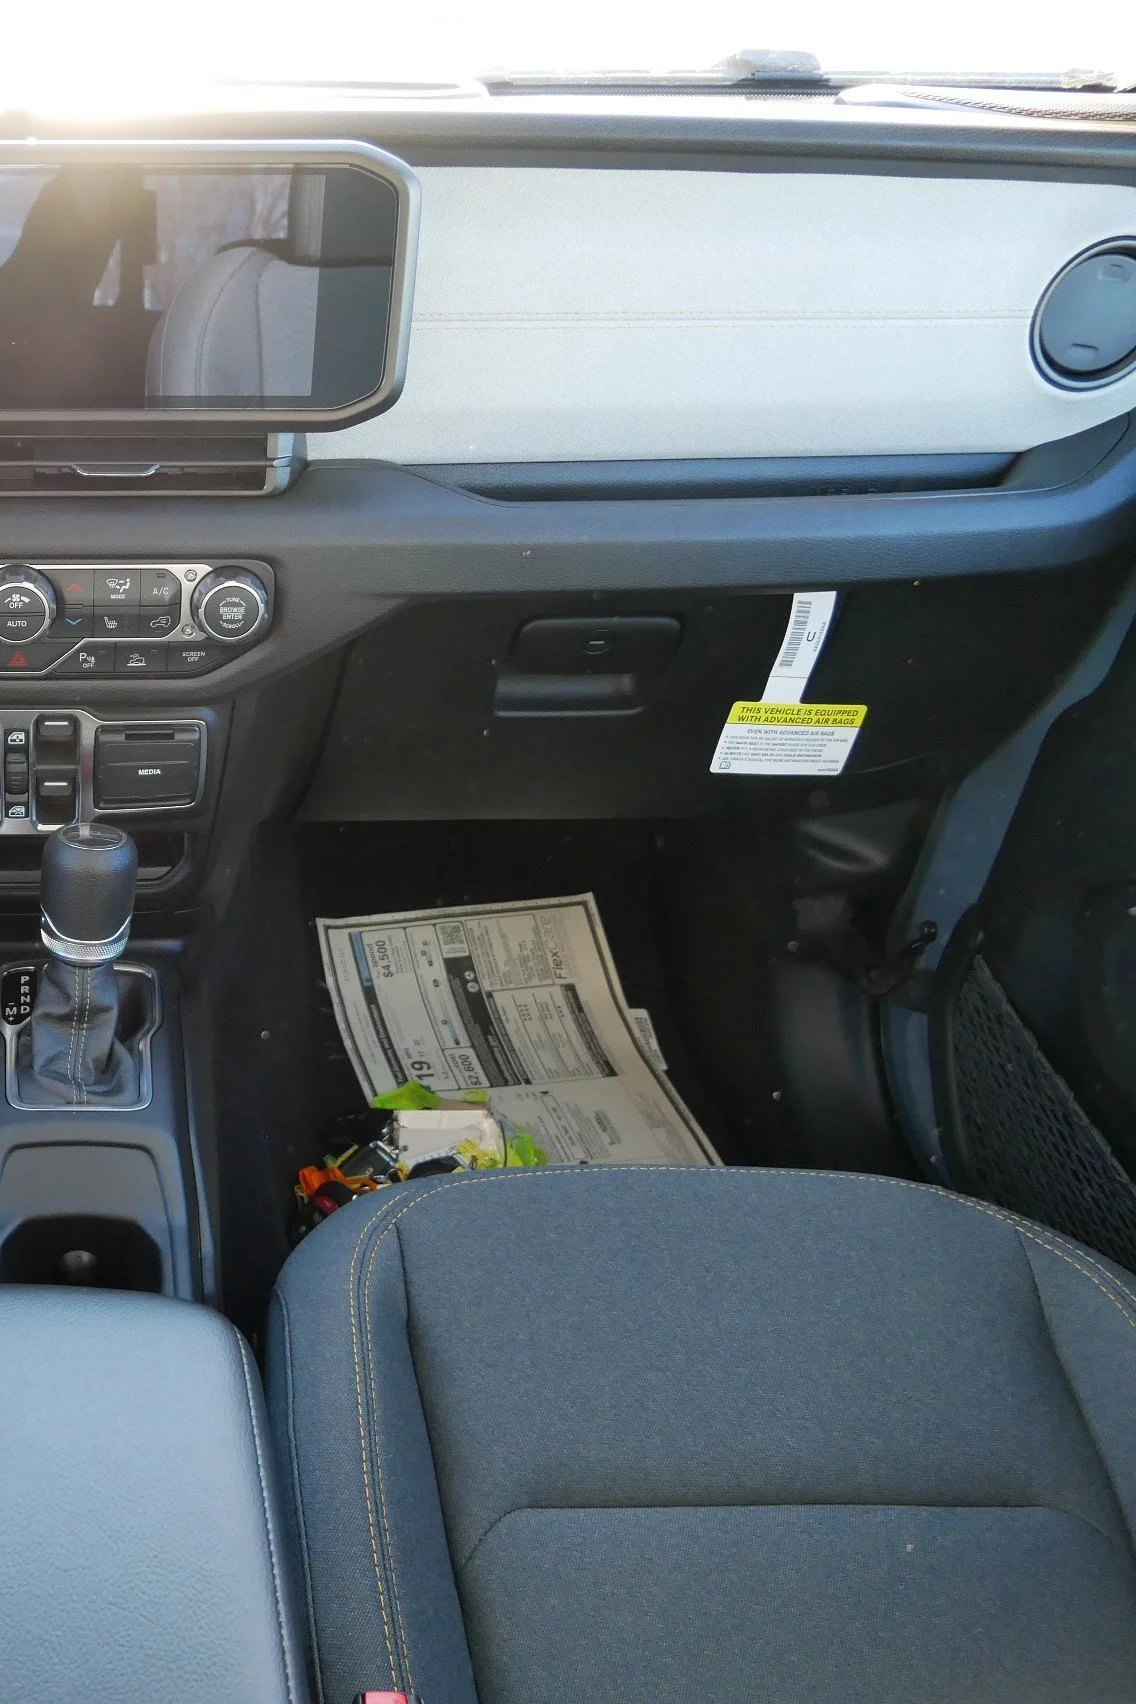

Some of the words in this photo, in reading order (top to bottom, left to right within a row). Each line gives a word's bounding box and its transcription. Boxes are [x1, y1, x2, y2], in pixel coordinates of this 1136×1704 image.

[764, 708, 803, 716] VEHICLE
[814, 709, 858, 717] EQUIPPED
[763, 716, 813, 724] ADVANCED
[366, 943, 377, 968] spend
[375, 940, 394, 978] $4,500
[21, 976, 30, 984] P
[21, 985, 30, 994] R
[21, 995, 30, 1004] N
[5, 1007, 17, 1016] M
[21, 1006, 30, 1014] D
[410, 1060, 434, 1080] 19
